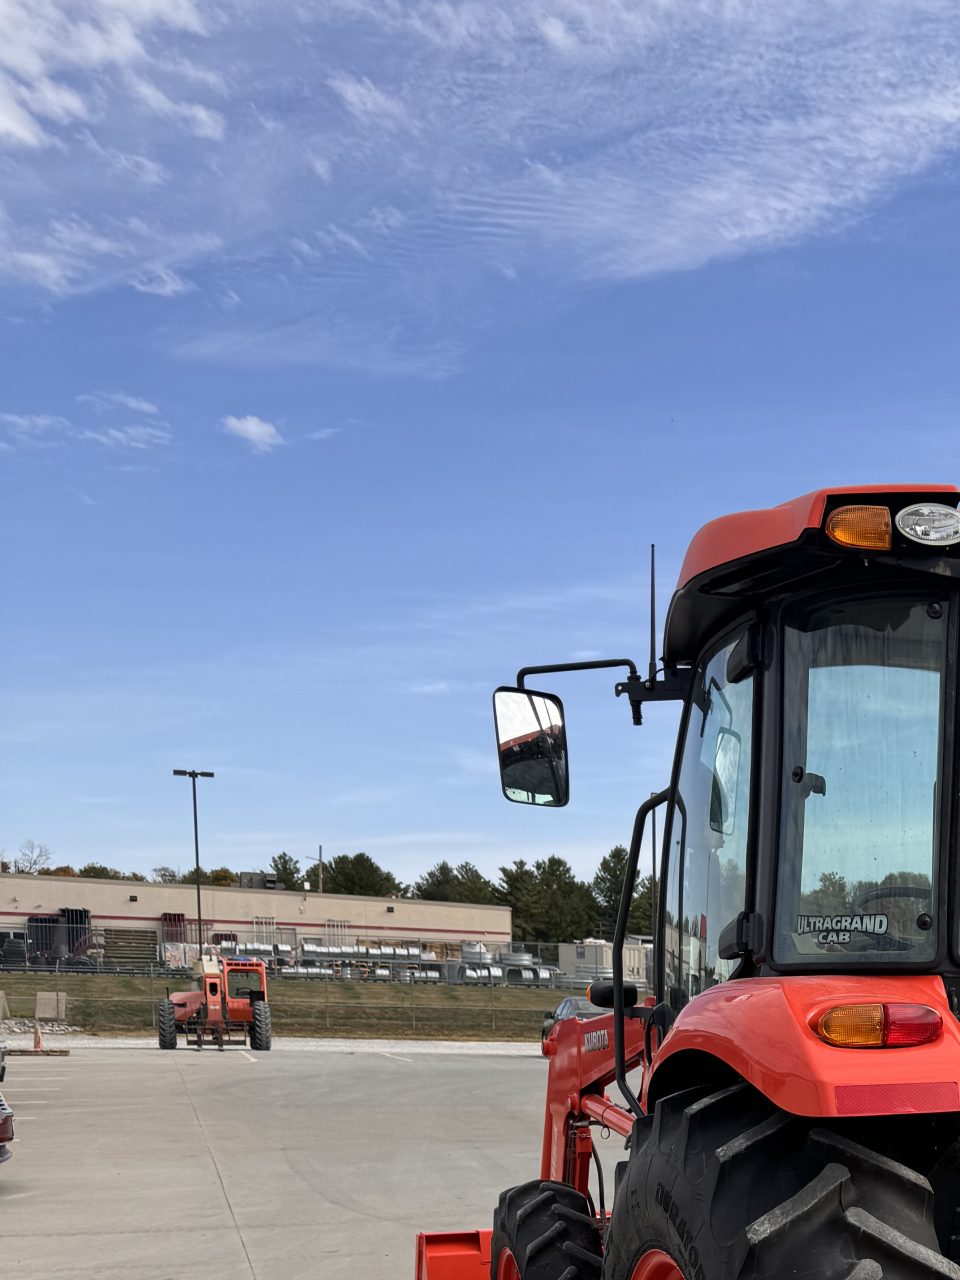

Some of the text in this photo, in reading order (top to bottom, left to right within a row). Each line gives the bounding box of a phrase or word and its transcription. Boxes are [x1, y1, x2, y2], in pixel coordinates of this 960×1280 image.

[797, 914, 888, 935] ULTRAGRAND
[817, 931, 851, 944] CAB
[584, 1028, 609, 1053] KUBOTA
